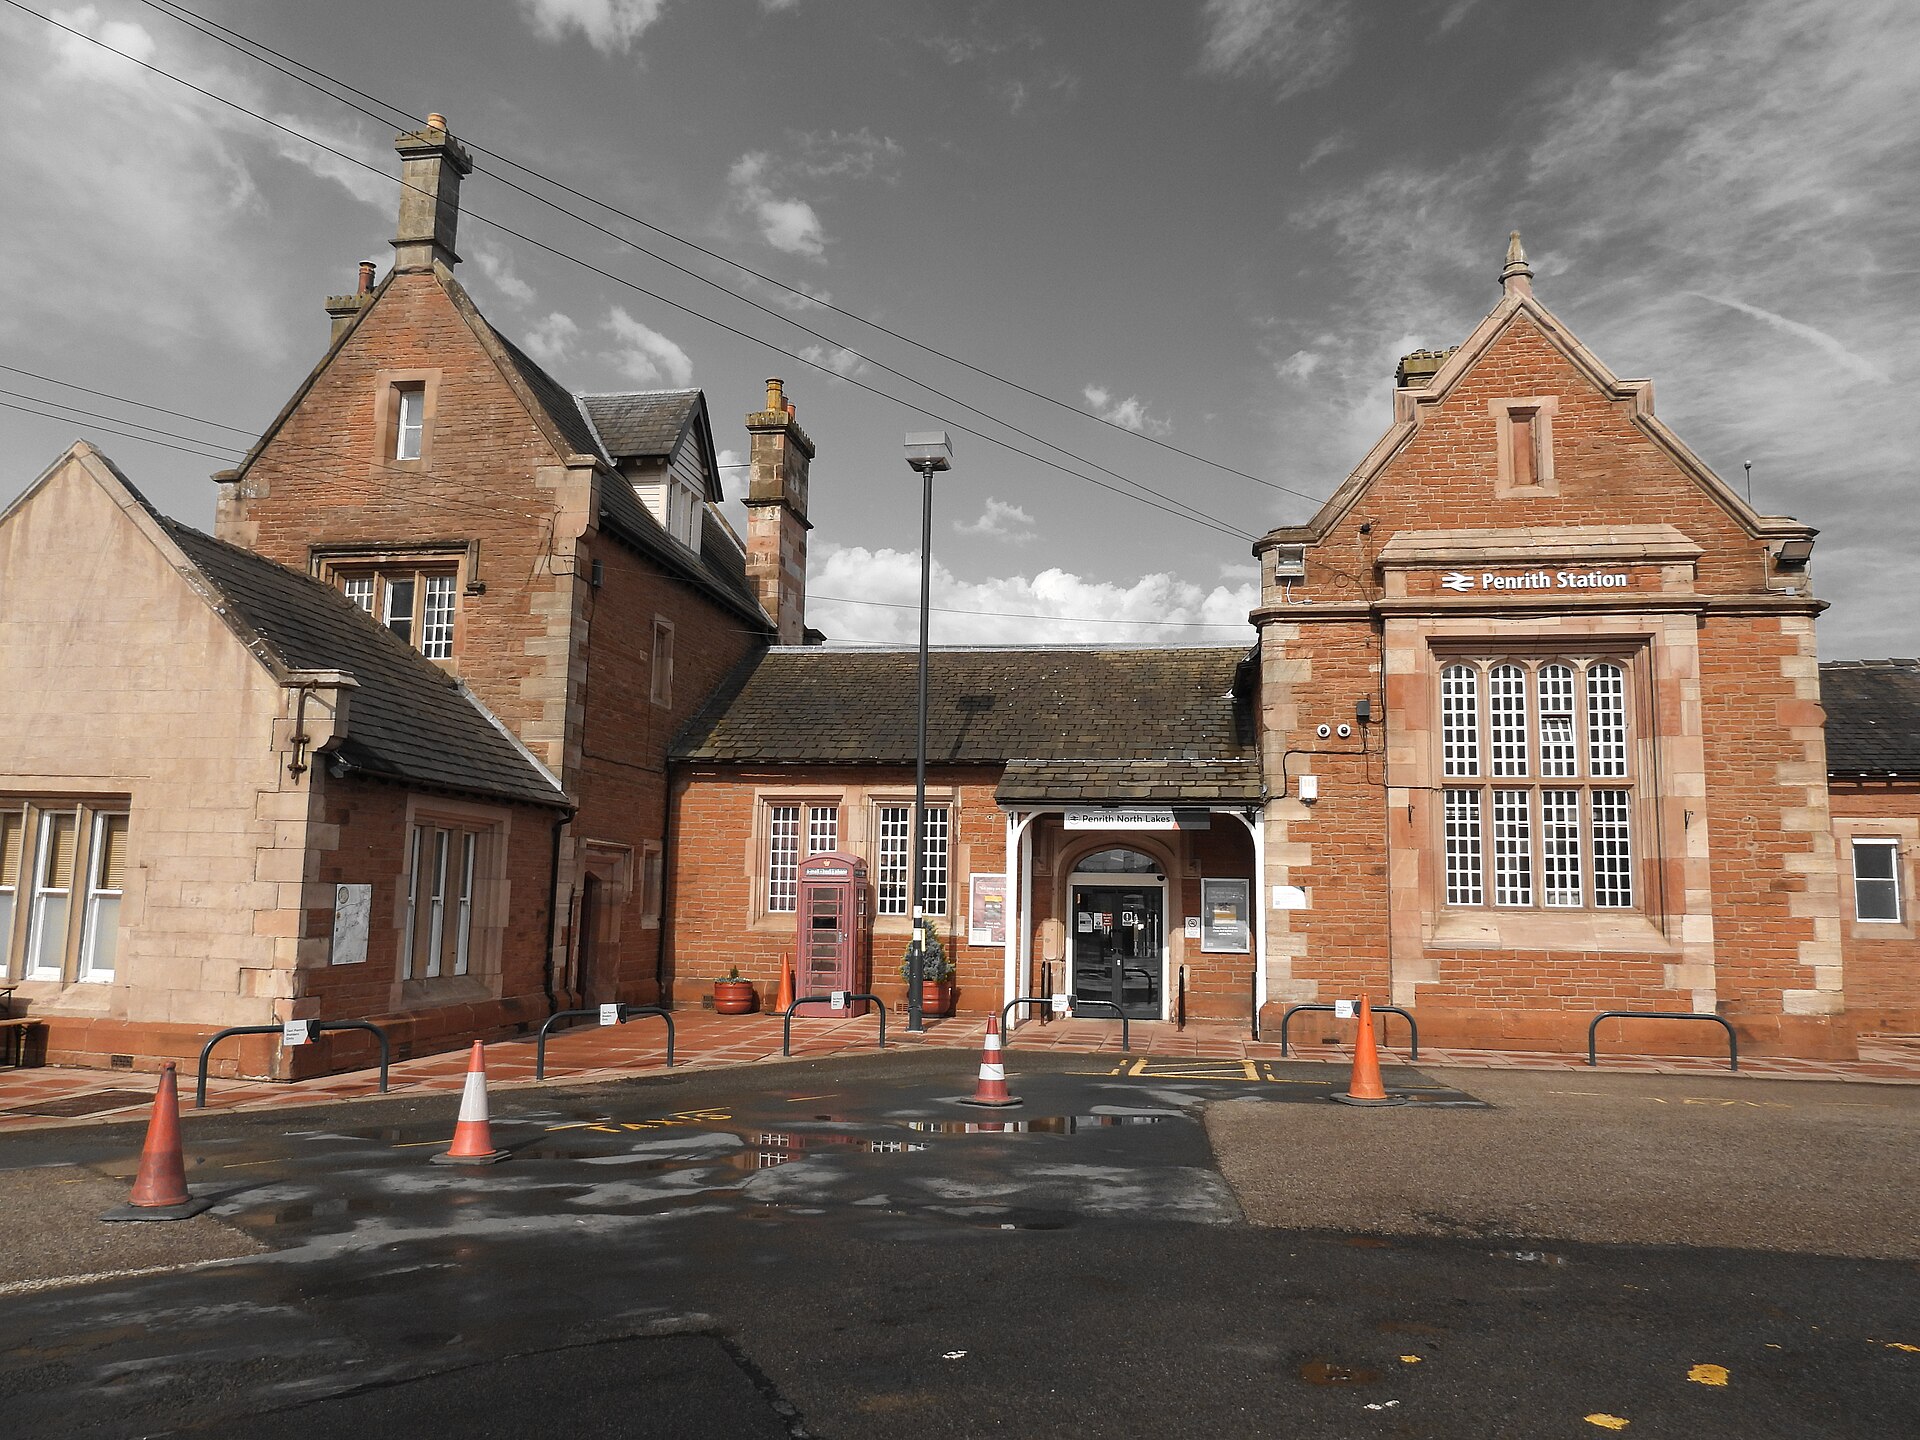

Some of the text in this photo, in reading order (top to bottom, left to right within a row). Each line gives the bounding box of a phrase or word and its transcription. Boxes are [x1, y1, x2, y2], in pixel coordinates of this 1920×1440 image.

[1482, 571, 1626, 589] Penrith Station
[1082, 815, 1170, 823] Penrith North Lakes
